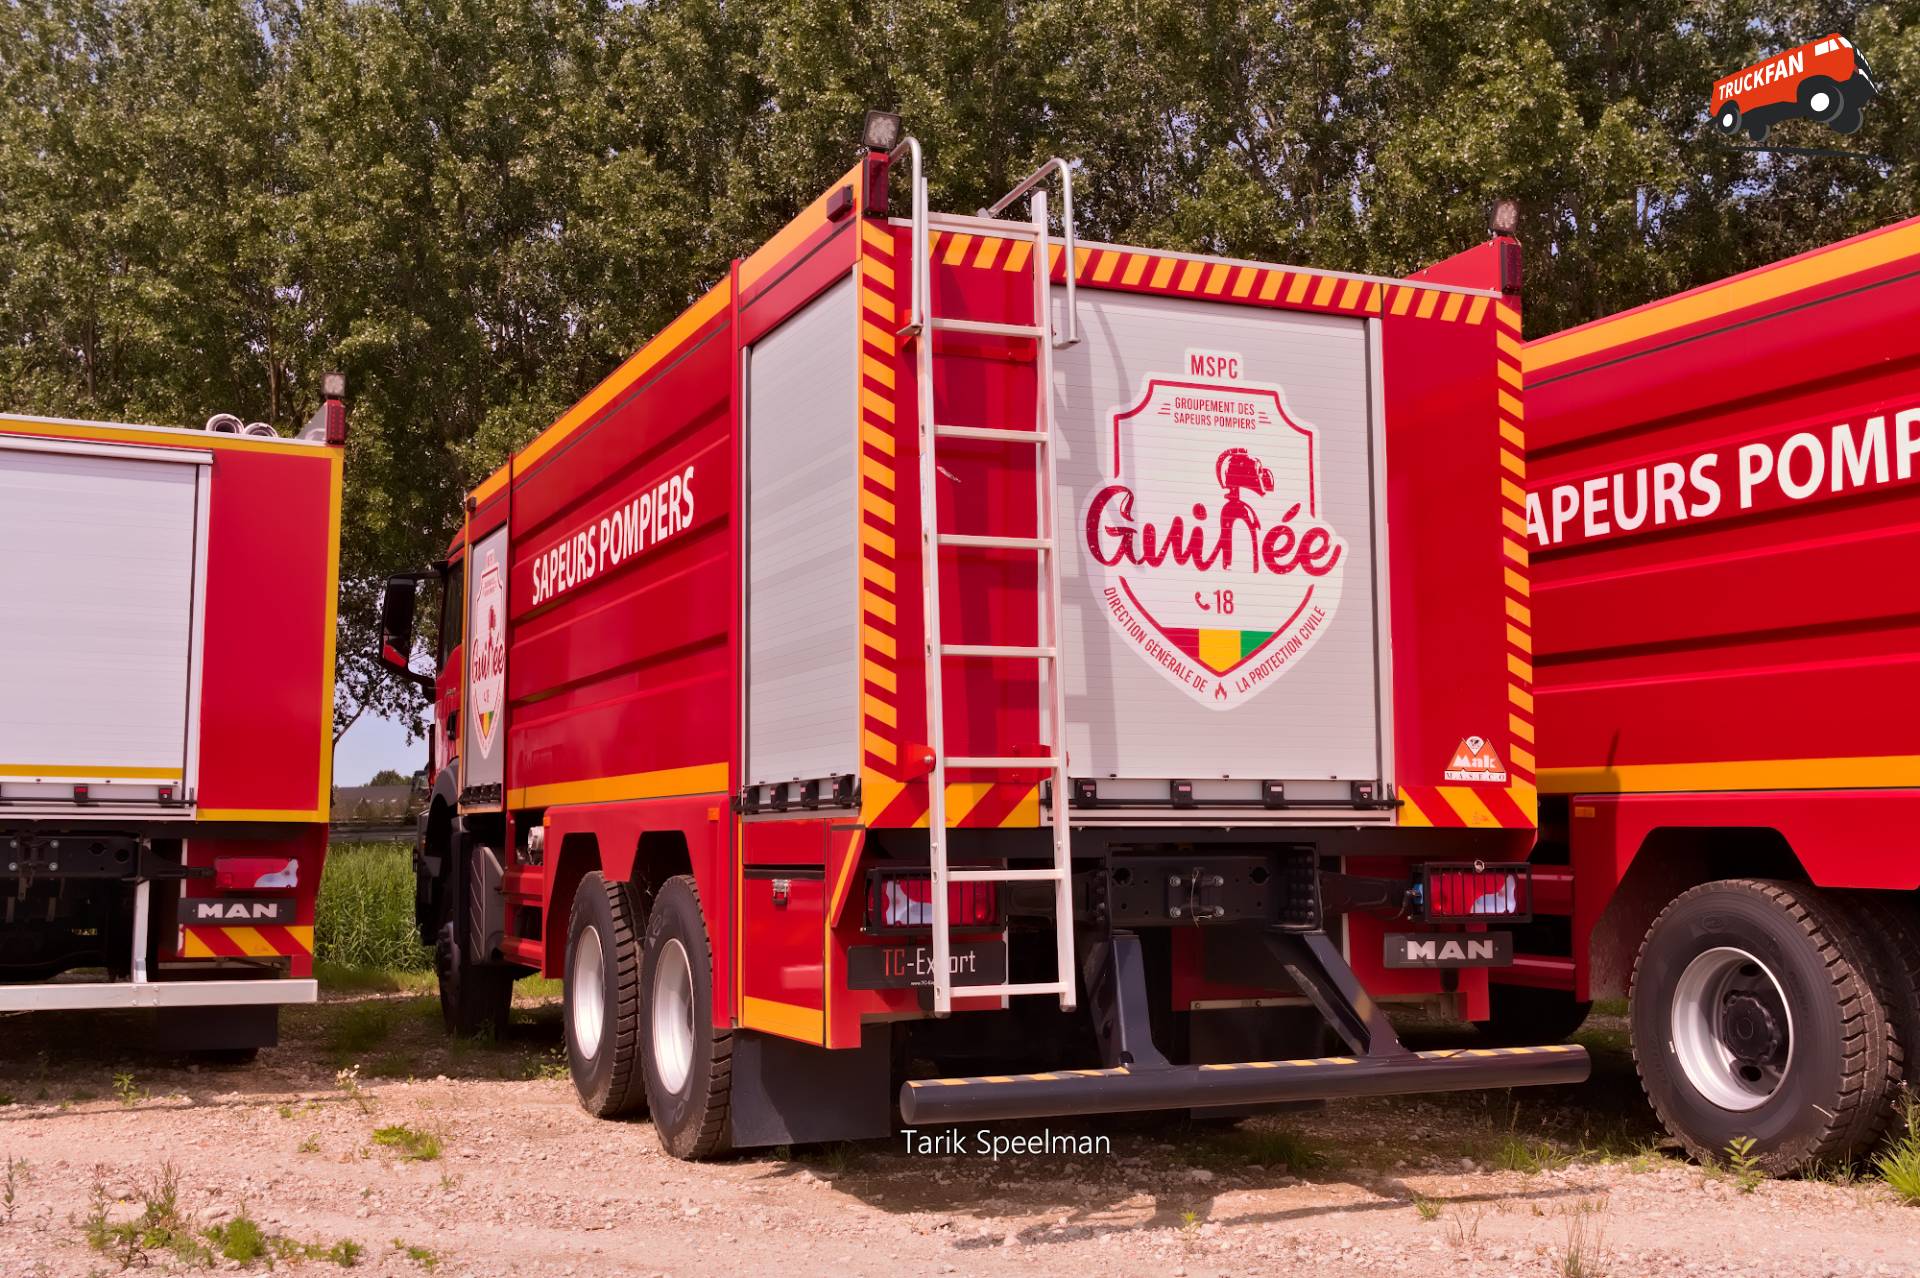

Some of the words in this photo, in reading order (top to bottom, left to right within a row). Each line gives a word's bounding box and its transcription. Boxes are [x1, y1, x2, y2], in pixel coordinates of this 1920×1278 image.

[1190, 354, 1239, 380] MSPC
[1174, 396, 1235, 414] GROUPEMENT
[1237, 402, 1256, 416] DES
[1173, 412, 1212, 427] SAPEURS
[1213, 415, 1257, 431] POMPIERS
[532, 525, 597, 606] SAPEURS
[600, 465, 695, 572] POMPIERS
[1085, 485, 1343, 577] Guinée
[1213, 589, 1235, 615] 18
[1103, 586, 1147, 646] DIRECTION
[1192, 674, 1209, 693] DE
[1235, 676, 1251, 694] LA
[1248, 633, 1303, 686] PROTECTION
[1298, 604, 1327, 640] CIVILE
[197, 902, 278, 919] MAN
[883, 948, 976, 976] TC-Exort
[1407, 940, 1494, 960] MAN
